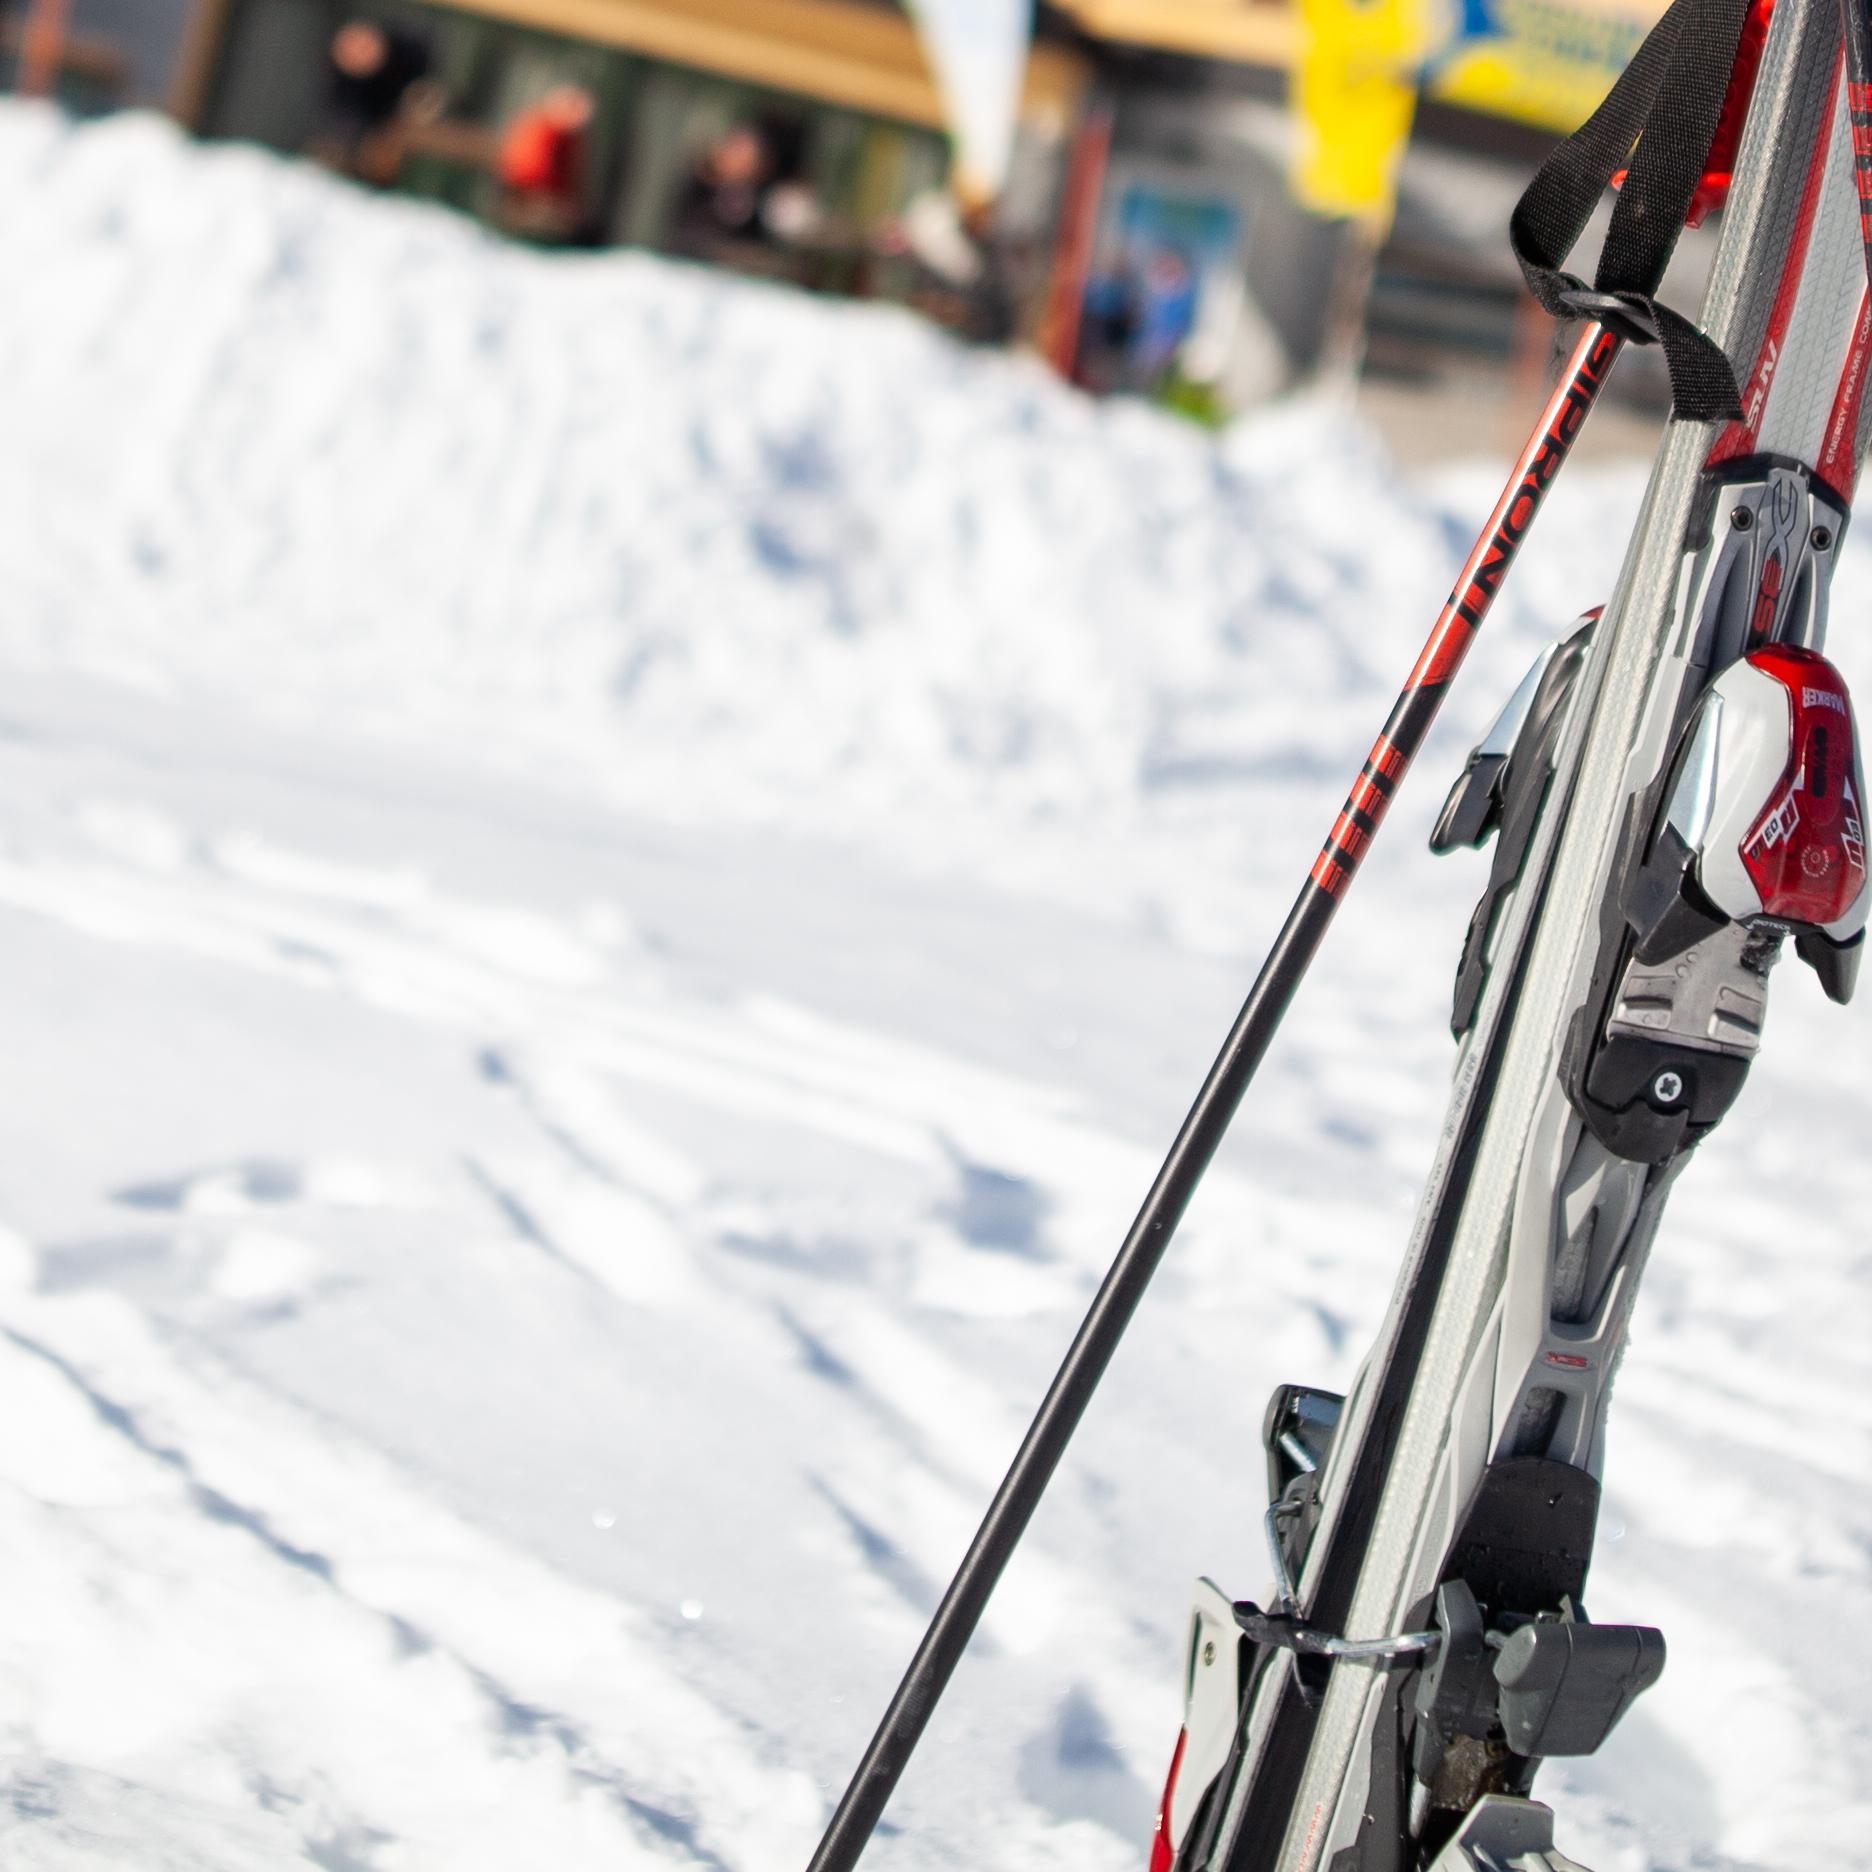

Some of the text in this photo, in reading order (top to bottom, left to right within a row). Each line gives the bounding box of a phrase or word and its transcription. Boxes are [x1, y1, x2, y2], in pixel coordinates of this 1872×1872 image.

[1473, 326, 1620, 600] GIPRON
[1825, 405, 1848, 464] ENERGY
[1841, 348, 1864, 403] FRAME
[1800, 686, 1846, 716] MARKER
